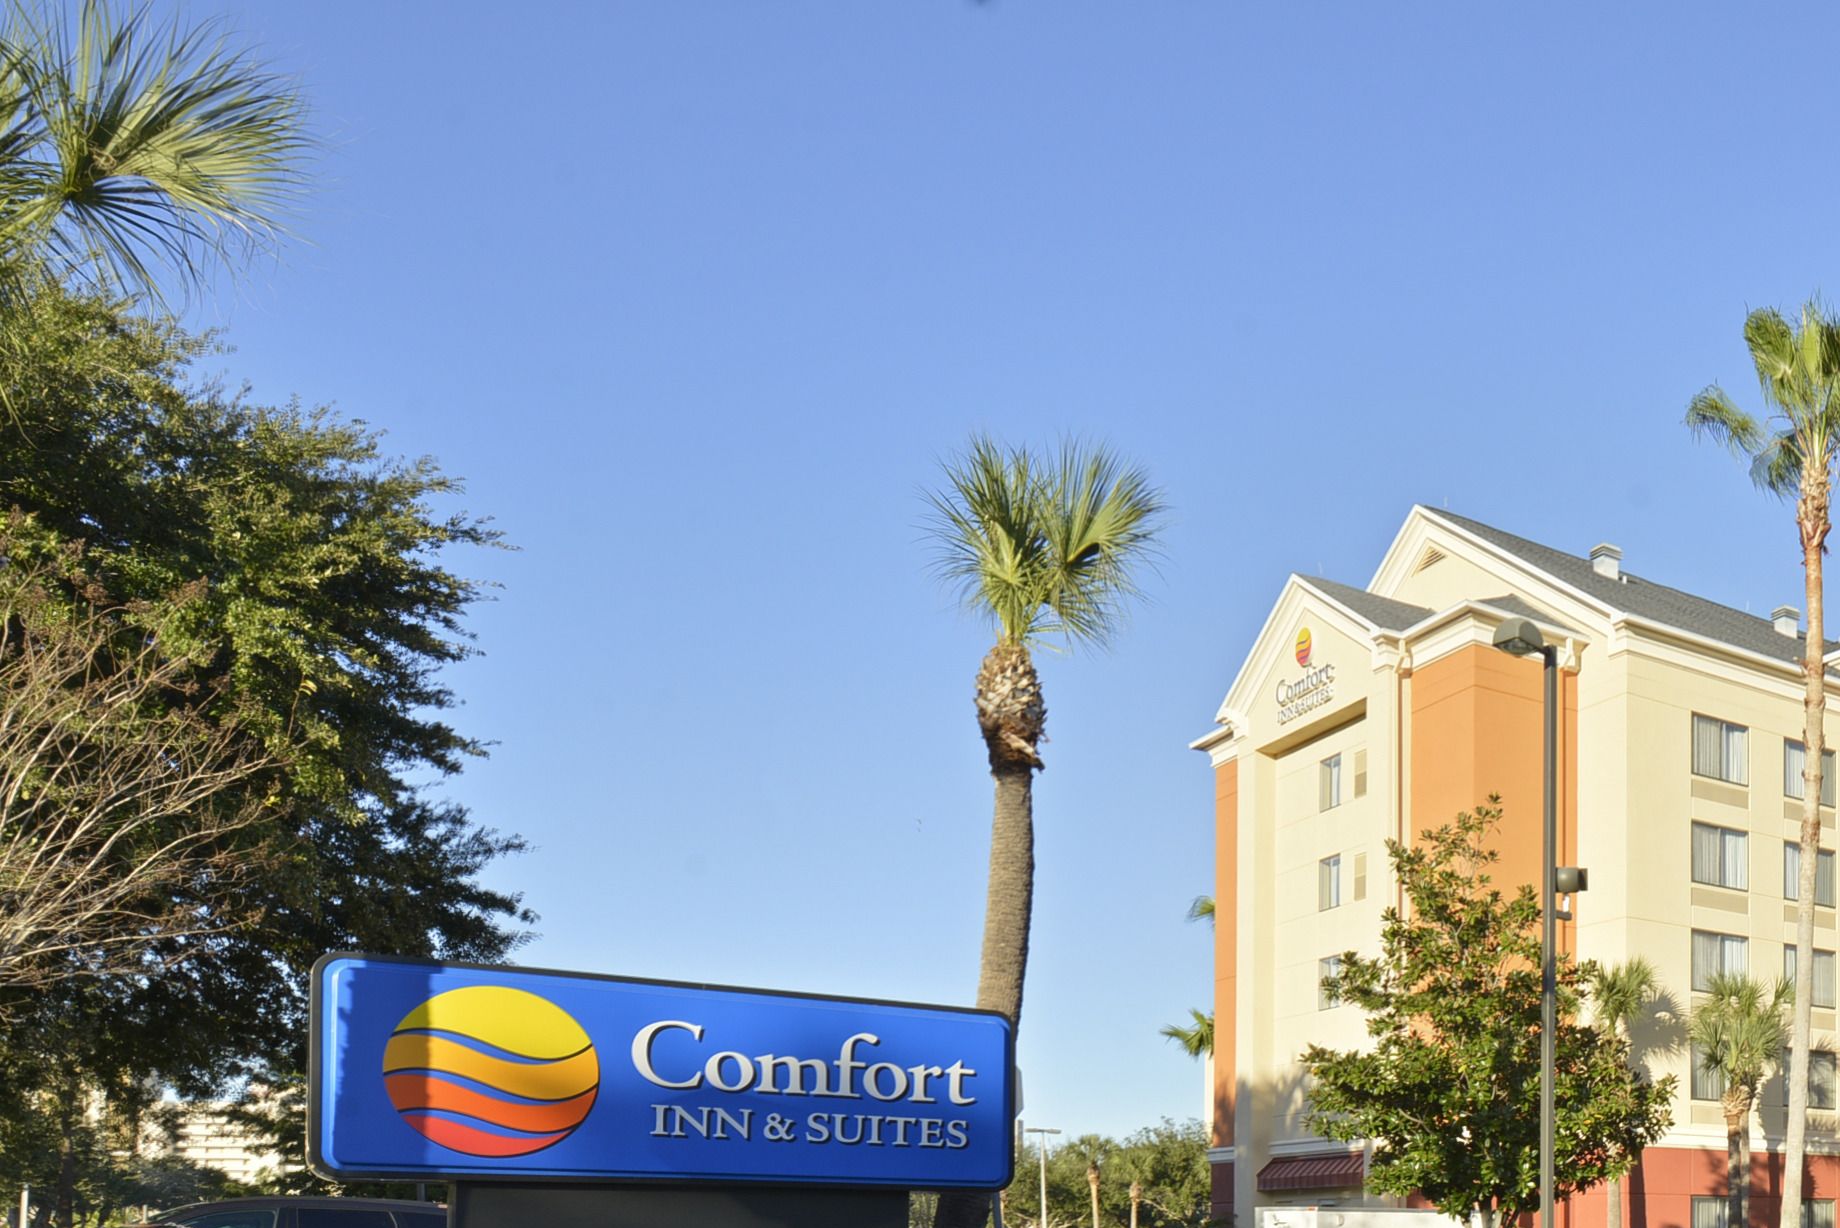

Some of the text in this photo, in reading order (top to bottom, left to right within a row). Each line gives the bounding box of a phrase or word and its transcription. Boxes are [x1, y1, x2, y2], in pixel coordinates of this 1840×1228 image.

[1276, 663, 1335, 706] Comfort
[631, 1020, 976, 1106] Comfort
[650, 1104, 968, 1148] INN & SUITES
